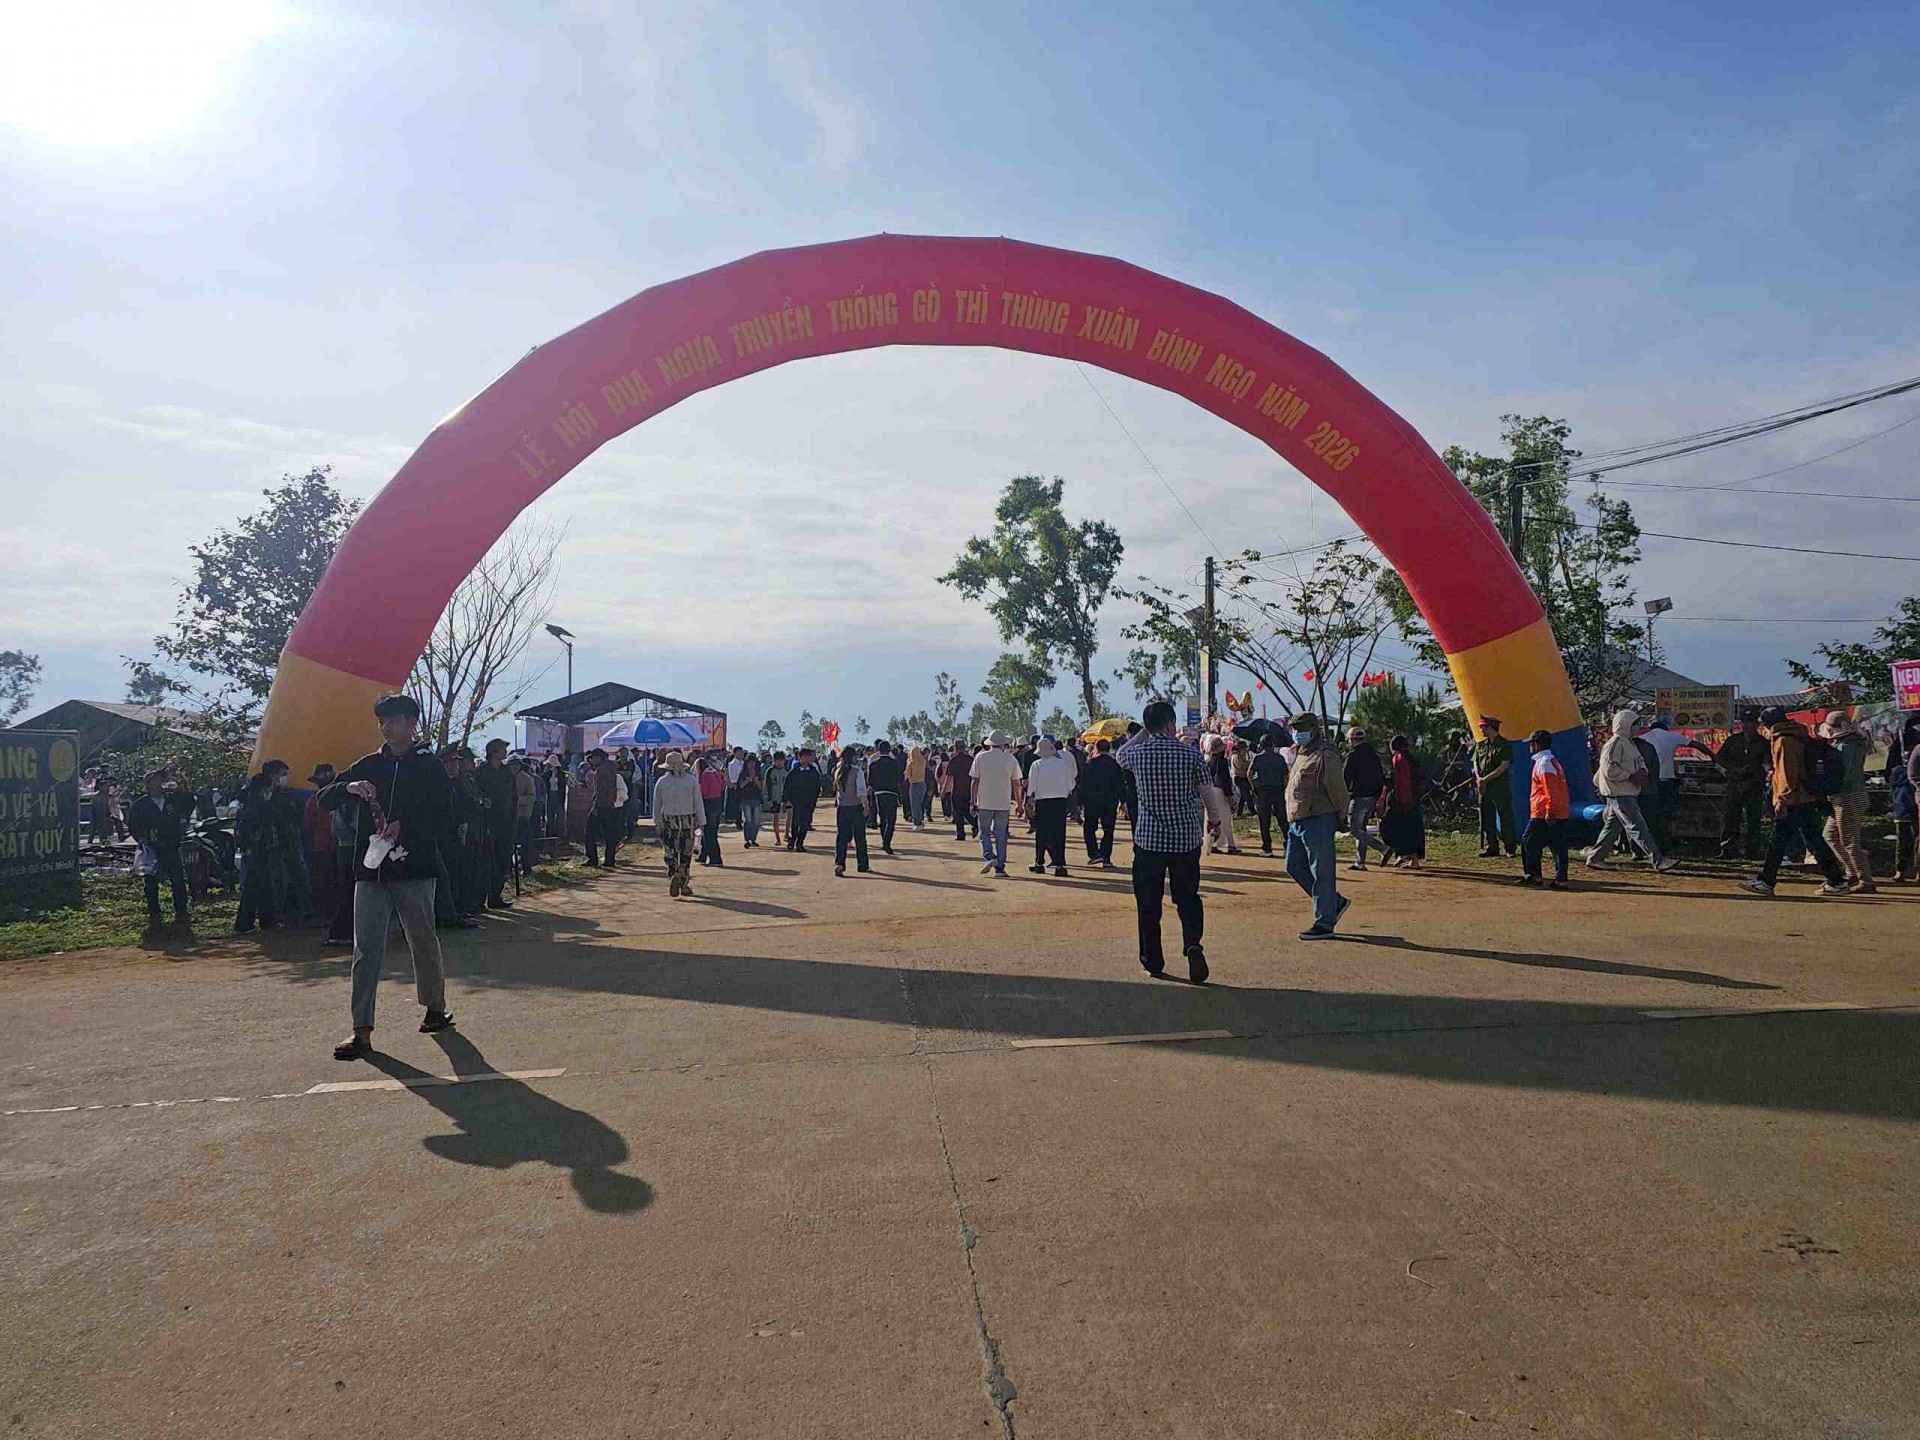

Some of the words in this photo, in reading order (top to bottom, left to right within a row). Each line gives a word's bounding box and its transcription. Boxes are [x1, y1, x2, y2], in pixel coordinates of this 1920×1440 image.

[600, 369, 654, 417] ĐUA
[655, 334, 722, 386] NGỰA
[727, 296, 814, 360] TRUYỀN
[826, 284, 899, 335] THỐNG
[912, 281, 941, 324] GÒ
[955, 282, 989, 325] THÌ
[1001, 290, 1070, 335] THÙNG
[1078, 306, 1140, 350] XUÂN
[1146, 327, 1204, 374] BÍNH
[1205, 353, 1257, 404] NGỌ
[1255, 382, 1311, 431] NĂM
[1303, 421, 1360, 472] 2026
